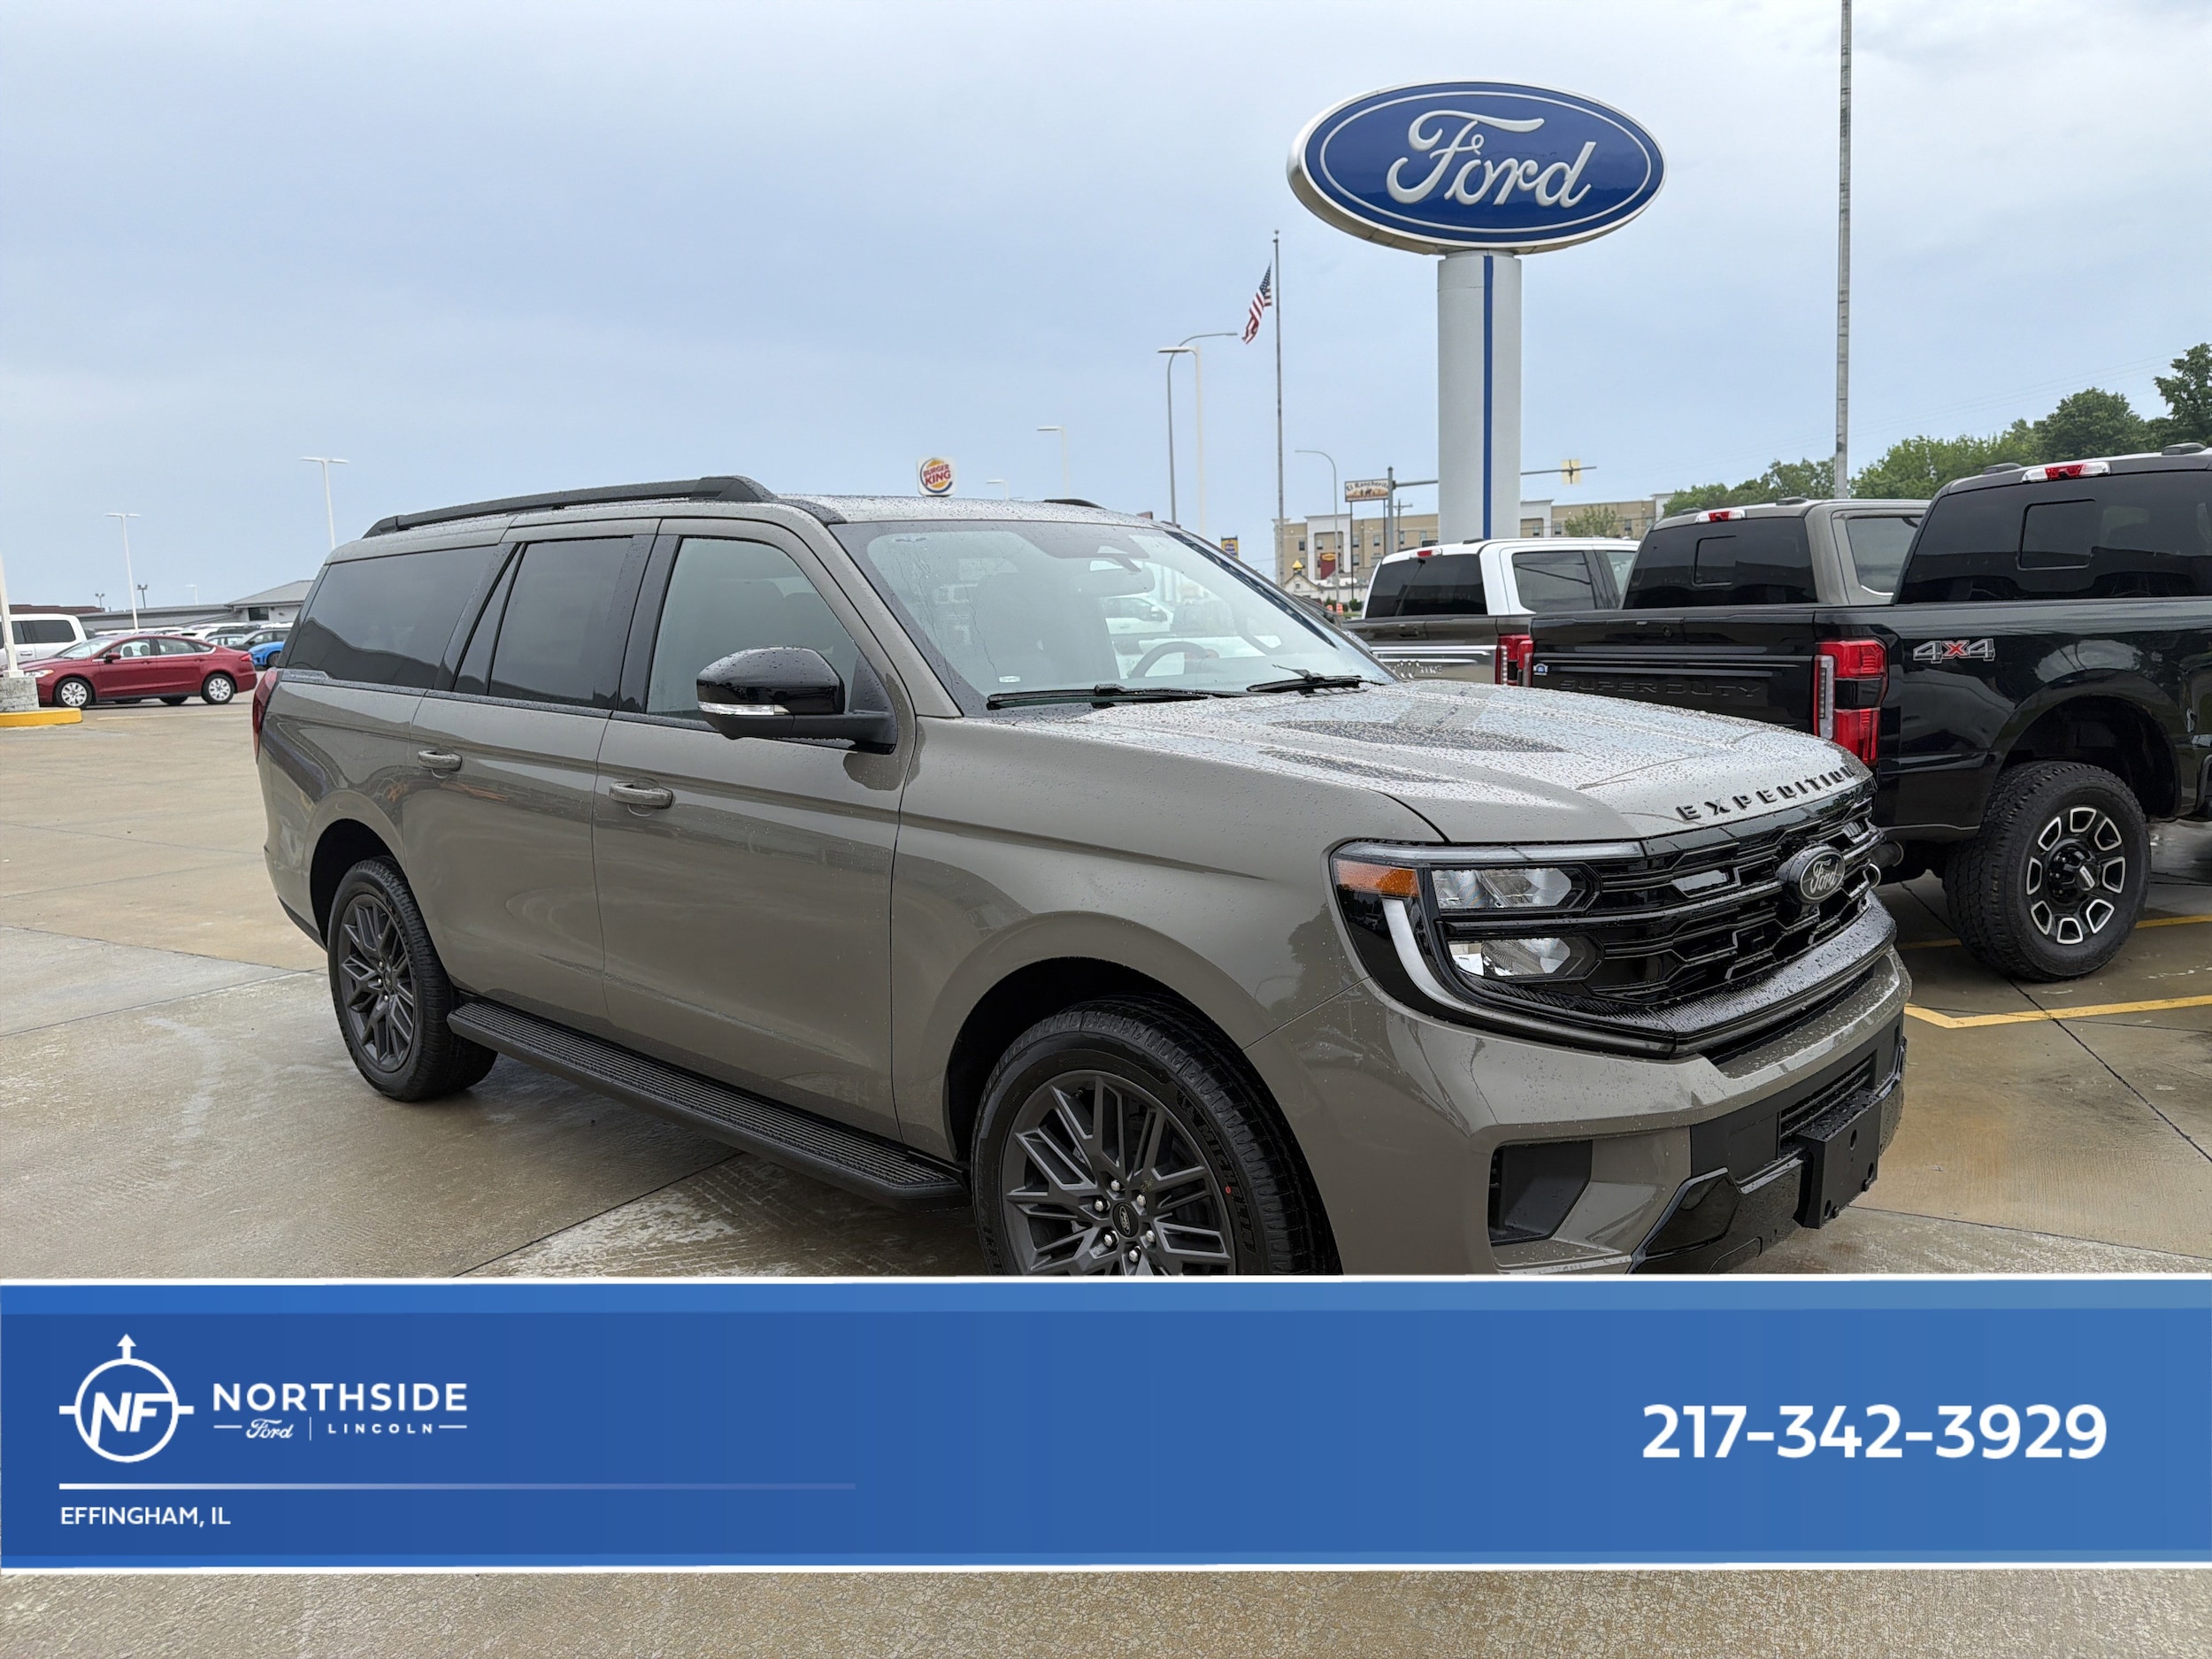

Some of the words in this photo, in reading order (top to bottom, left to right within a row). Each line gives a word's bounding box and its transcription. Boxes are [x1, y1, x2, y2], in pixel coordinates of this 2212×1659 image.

[1386, 109, 1598, 209] Ford
[923, 464, 949, 478] BURGER
[925, 470, 951, 487] KING
[1559, 680, 1657, 694] SUPER
[1666, 682, 1763, 698] DUTY
[1675, 765, 1856, 821] EXPEDITION
[1809, 858, 1839, 895] Ford
